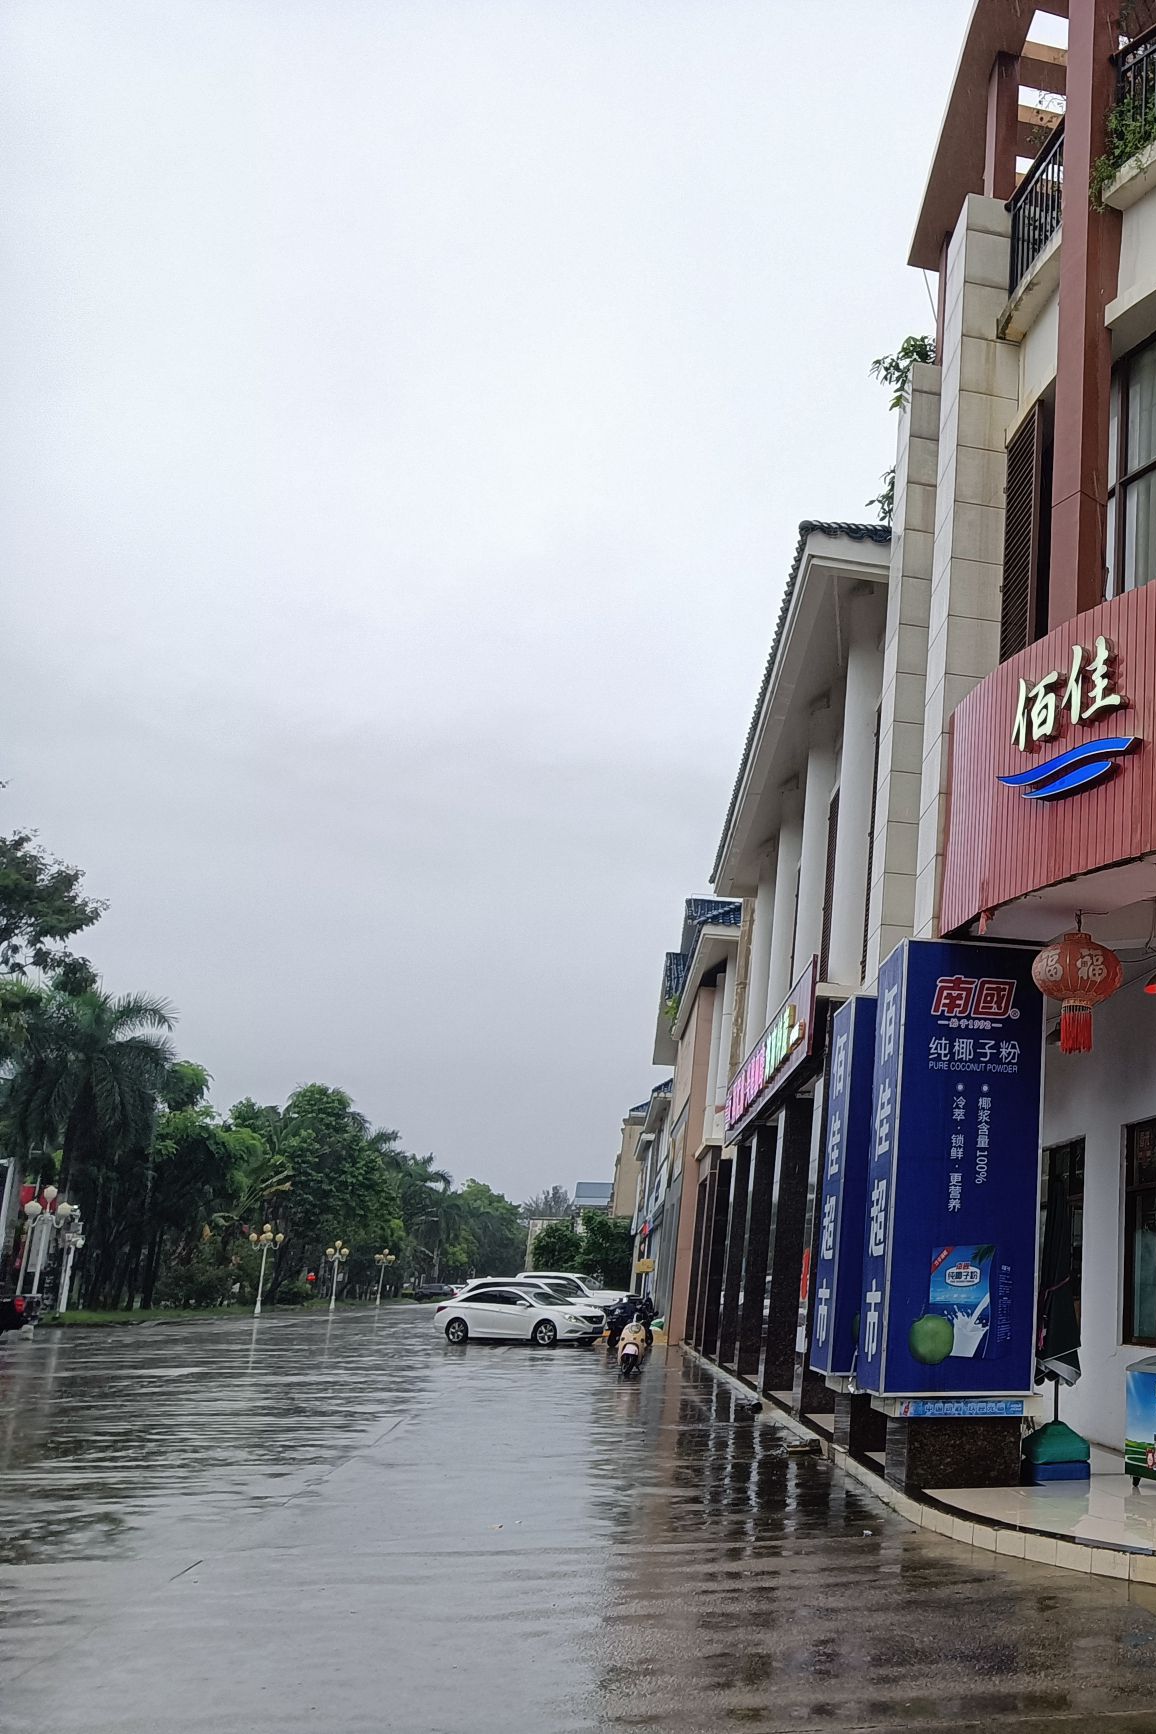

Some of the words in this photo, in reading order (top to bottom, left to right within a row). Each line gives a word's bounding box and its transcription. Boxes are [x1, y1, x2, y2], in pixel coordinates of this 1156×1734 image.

[1012, 636, 1127, 752] 佰佳
[931, 975, 1017, 1018] 南國
[1076, 948, 1107, 981] 福
[929, 1036, 1020, 1063] 纯椰子粉
[929, 1061, 949, 1070] PURE
[950, 1062, 986, 1072] COCONUT
[987, 1063, 1018, 1073] POWDER
[864, 983, 898, 1362] 佰佳超市
[975, 1097, 991, 1184] 椰浆含量100%
[816, 1031, 848, 1347] 佰佳超市
